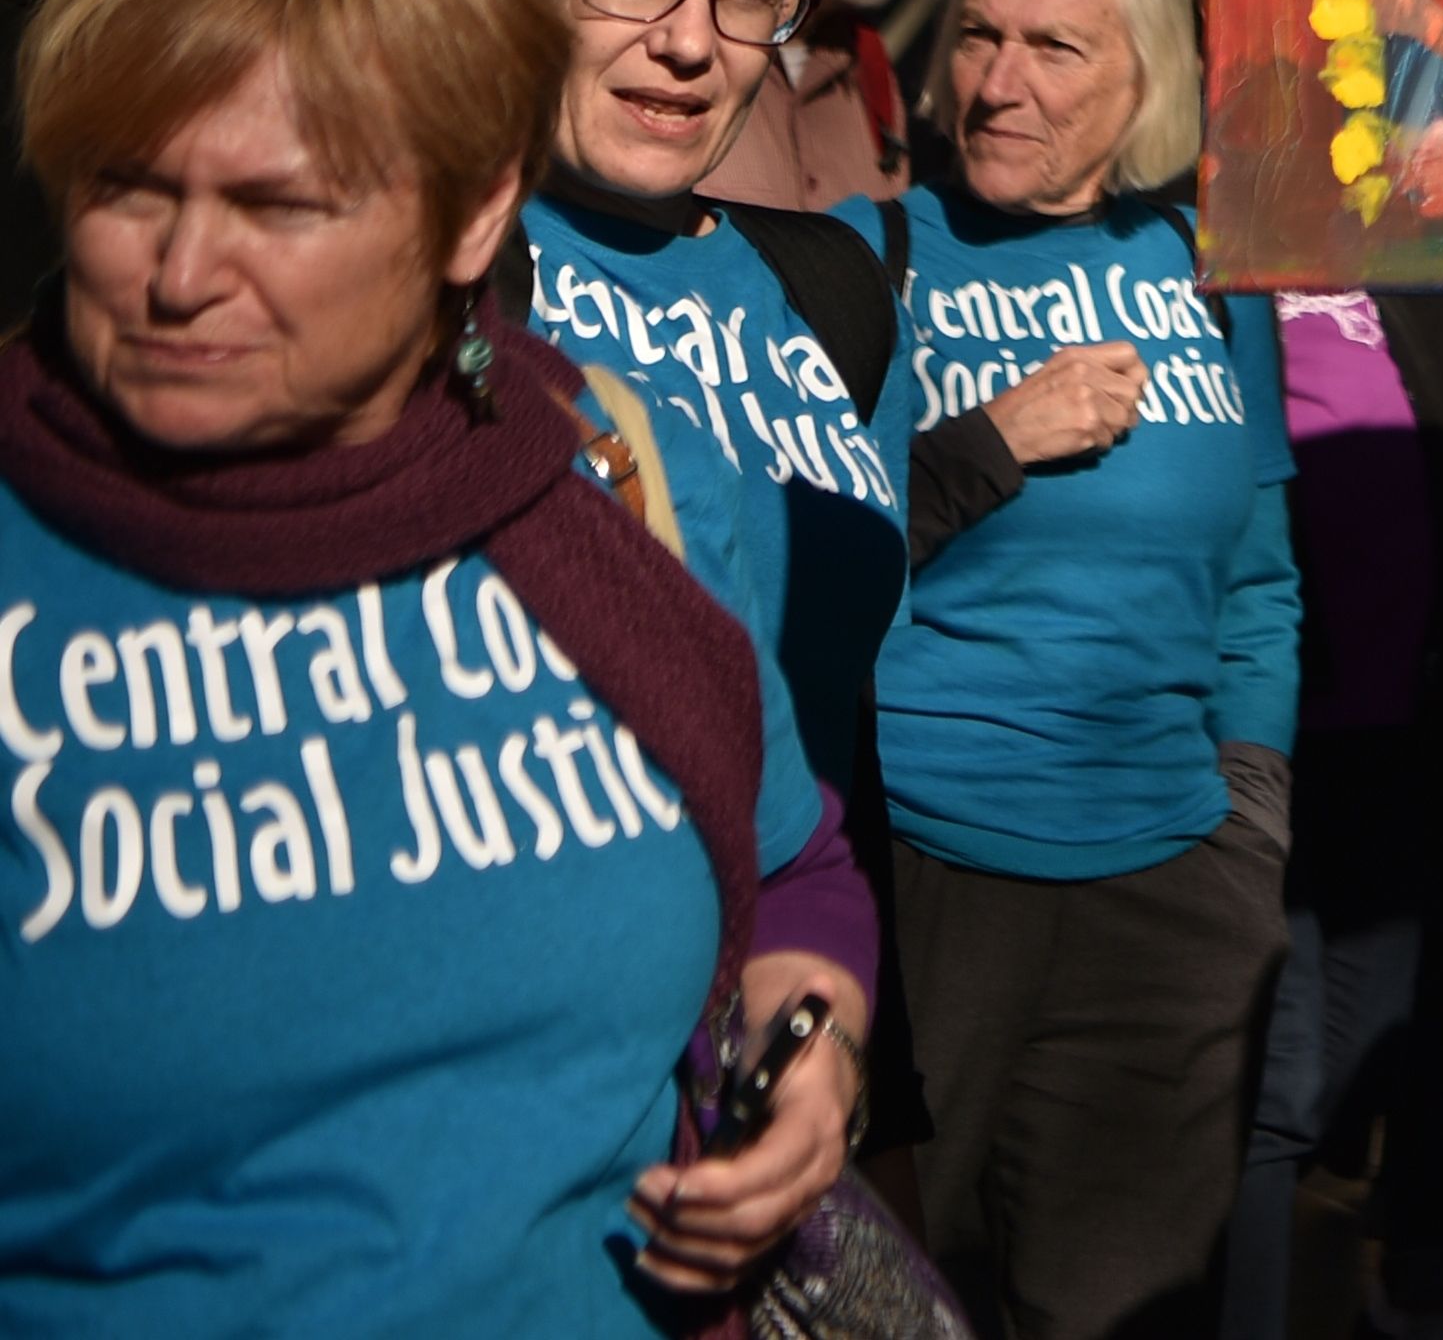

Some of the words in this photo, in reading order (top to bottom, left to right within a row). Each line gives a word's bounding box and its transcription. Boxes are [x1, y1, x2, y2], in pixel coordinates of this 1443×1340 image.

[912, 347, 1048, 432] Soci
[1135, 347, 1245, 426] ustic
[0, 584, 407, 763] Central
[11, 737, 356, 945] Social
[391, 700, 684, 886] Justic
